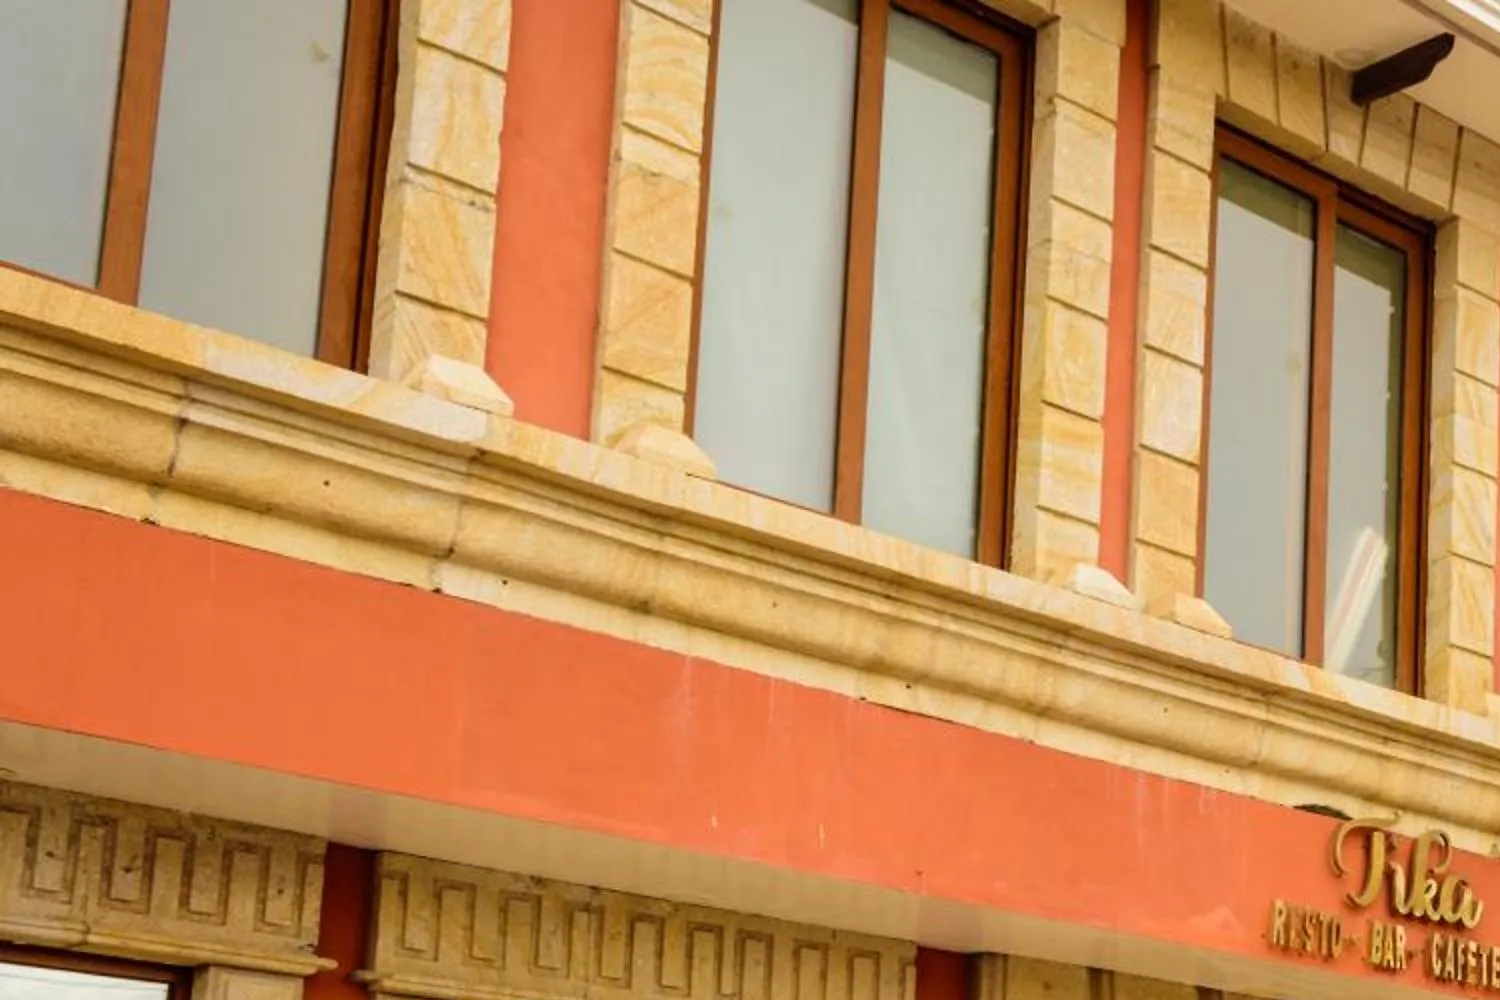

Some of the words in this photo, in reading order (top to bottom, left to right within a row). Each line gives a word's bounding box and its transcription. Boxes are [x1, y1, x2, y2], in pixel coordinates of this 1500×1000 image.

[1330, 816, 1484, 929] Tika
[1270, 898, 1343, 959] RESTO
[1369, 919, 1407, 970] BAR
